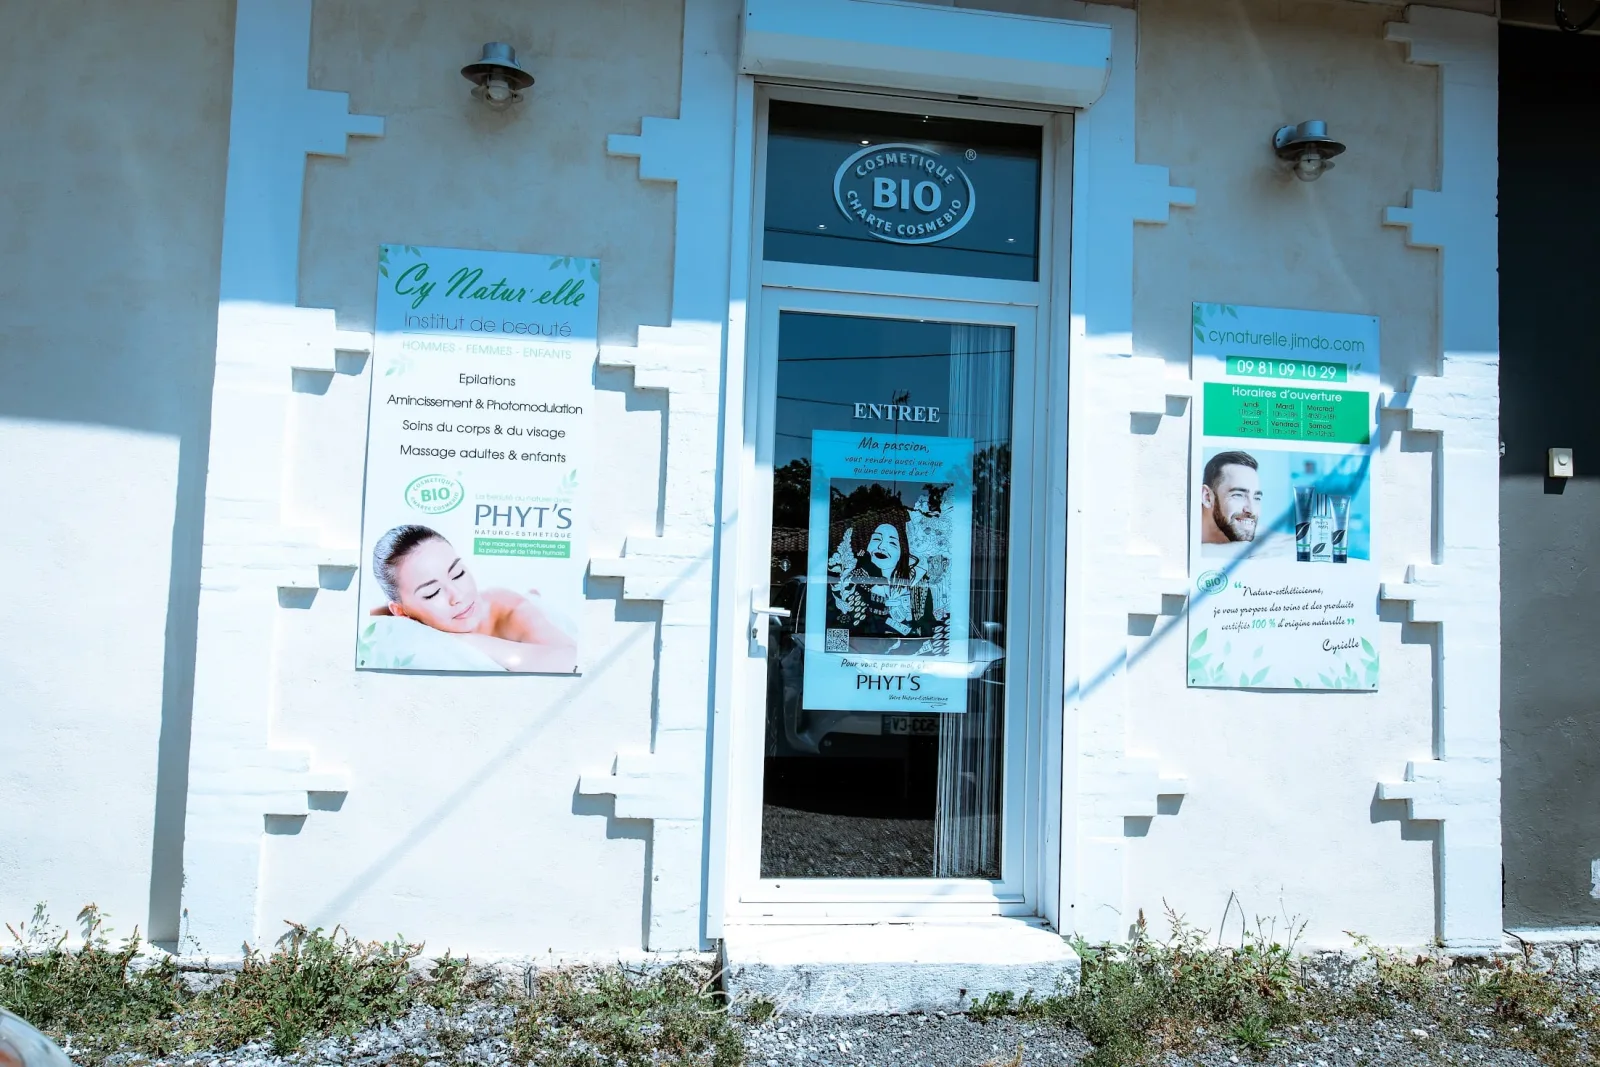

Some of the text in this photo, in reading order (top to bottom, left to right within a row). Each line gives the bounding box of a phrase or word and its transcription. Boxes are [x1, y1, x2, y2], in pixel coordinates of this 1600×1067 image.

[856, 152, 955, 186] COSMETIQUE
[873, 177, 942, 212] BIO
[847, 190, 962, 236] CHARTE COSMEBIO
[394, 263, 437, 309] Cy
[404, 312, 572, 338] Institut de beauté
[1208, 329, 1365, 352] cynaturelle.jimdo.com
[402, 340, 456, 353] HOMMES
[466, 344, 513, 356] FEMMES
[523, 347, 572, 360] ENFANTS
[1236, 359, 1337, 379] 09 81 09 10 29
[459, 373, 516, 387] Epilations
[1232, 386, 1342, 402] Horaires d'ouverture
[387, 394, 583, 415] Amincissement & Photomodulation
[853, 402, 941, 424] ENTREE
[1306, 405, 1335, 413] Mercredi
[402, 420, 566, 440] Soins du corps & du visage
[400, 445, 566, 463] Massage adultes & enfants
[857, 436, 930, 454] Ma passion,
[853, 465, 878, 475] qu'une
[881, 468, 906, 476] oeuvre
[908, 467, 929, 477] d'art
[865, 455, 893, 464] rendre
[894, 458, 915, 466] aussi
[918, 459, 944, 469] unique
[421, 487, 450, 502] BIO
[474, 503, 572, 530] PHYT'S
[474, 529, 572, 539] NATURO-ESTHETIQUE
[1205, 577, 1221, 589] BIO
[1213, 607, 1221, 618] je
[1240, 605, 1268, 616] propose
[1269, 602, 1282, 612] des
[1283, 603, 1300, 612] soins
[1302, 602, 1309, 610] et
[1310, 601, 1322, 610] des
[1323, 599, 1354, 613] produits
[1221, 621, 1250, 633] certifiés
[1251, 619, 1267, 629] 100
[1268, 619, 1276, 628] %
[1277, 617, 1311, 631] d'origine
[1321, 637, 1360, 655] Cyrielle
[841, 658, 859, 668] Pour
[880, 662, 897, 671] pour
[856, 673, 921, 691] PHYT'S
